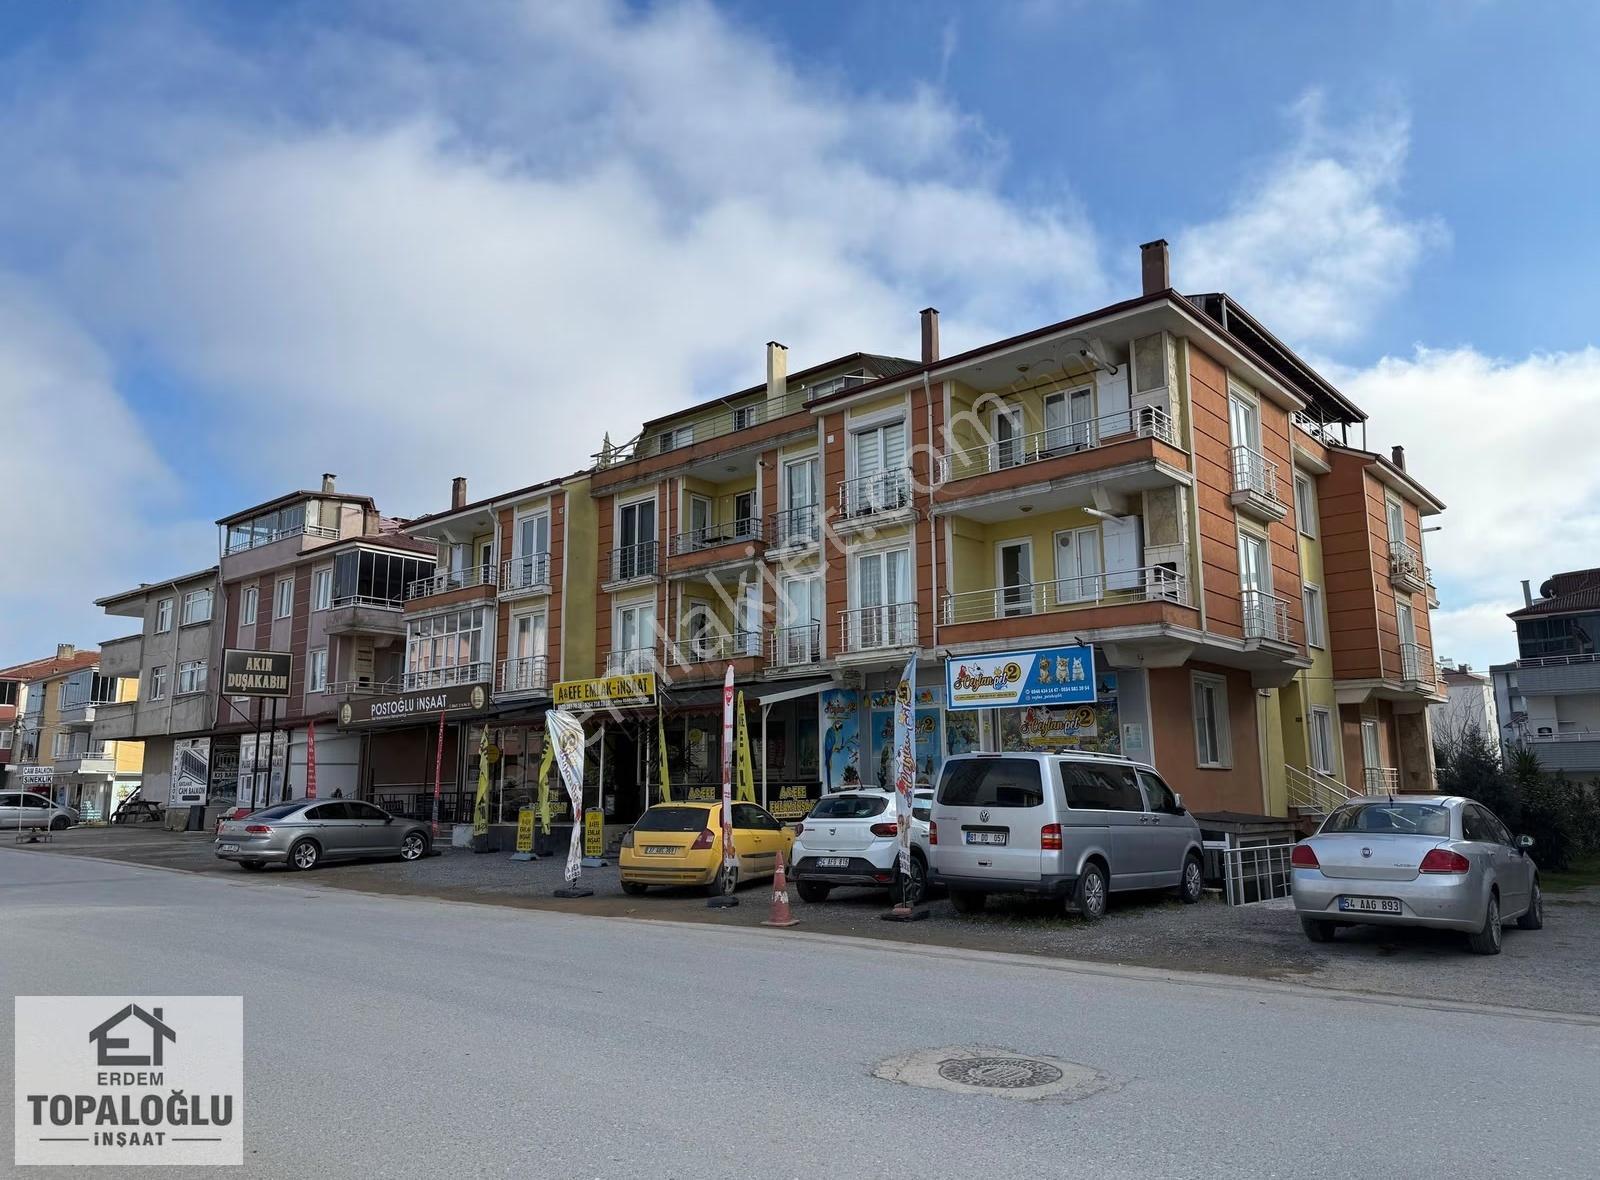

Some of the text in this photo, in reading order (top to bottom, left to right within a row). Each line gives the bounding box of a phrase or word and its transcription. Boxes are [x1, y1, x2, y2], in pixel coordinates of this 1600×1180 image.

[245, 656, 273, 672] AKIN
[1007, 665, 1018, 680] 2
[227, 672, 288, 692] DUŞAKABİN
[558, 684, 582, 701] A&EFE
[371, 698, 414, 716] POSTOĞLU
[1080, 709, 1091, 725] 2
[1344, 898, 1399, 911] 54 AAG 893
